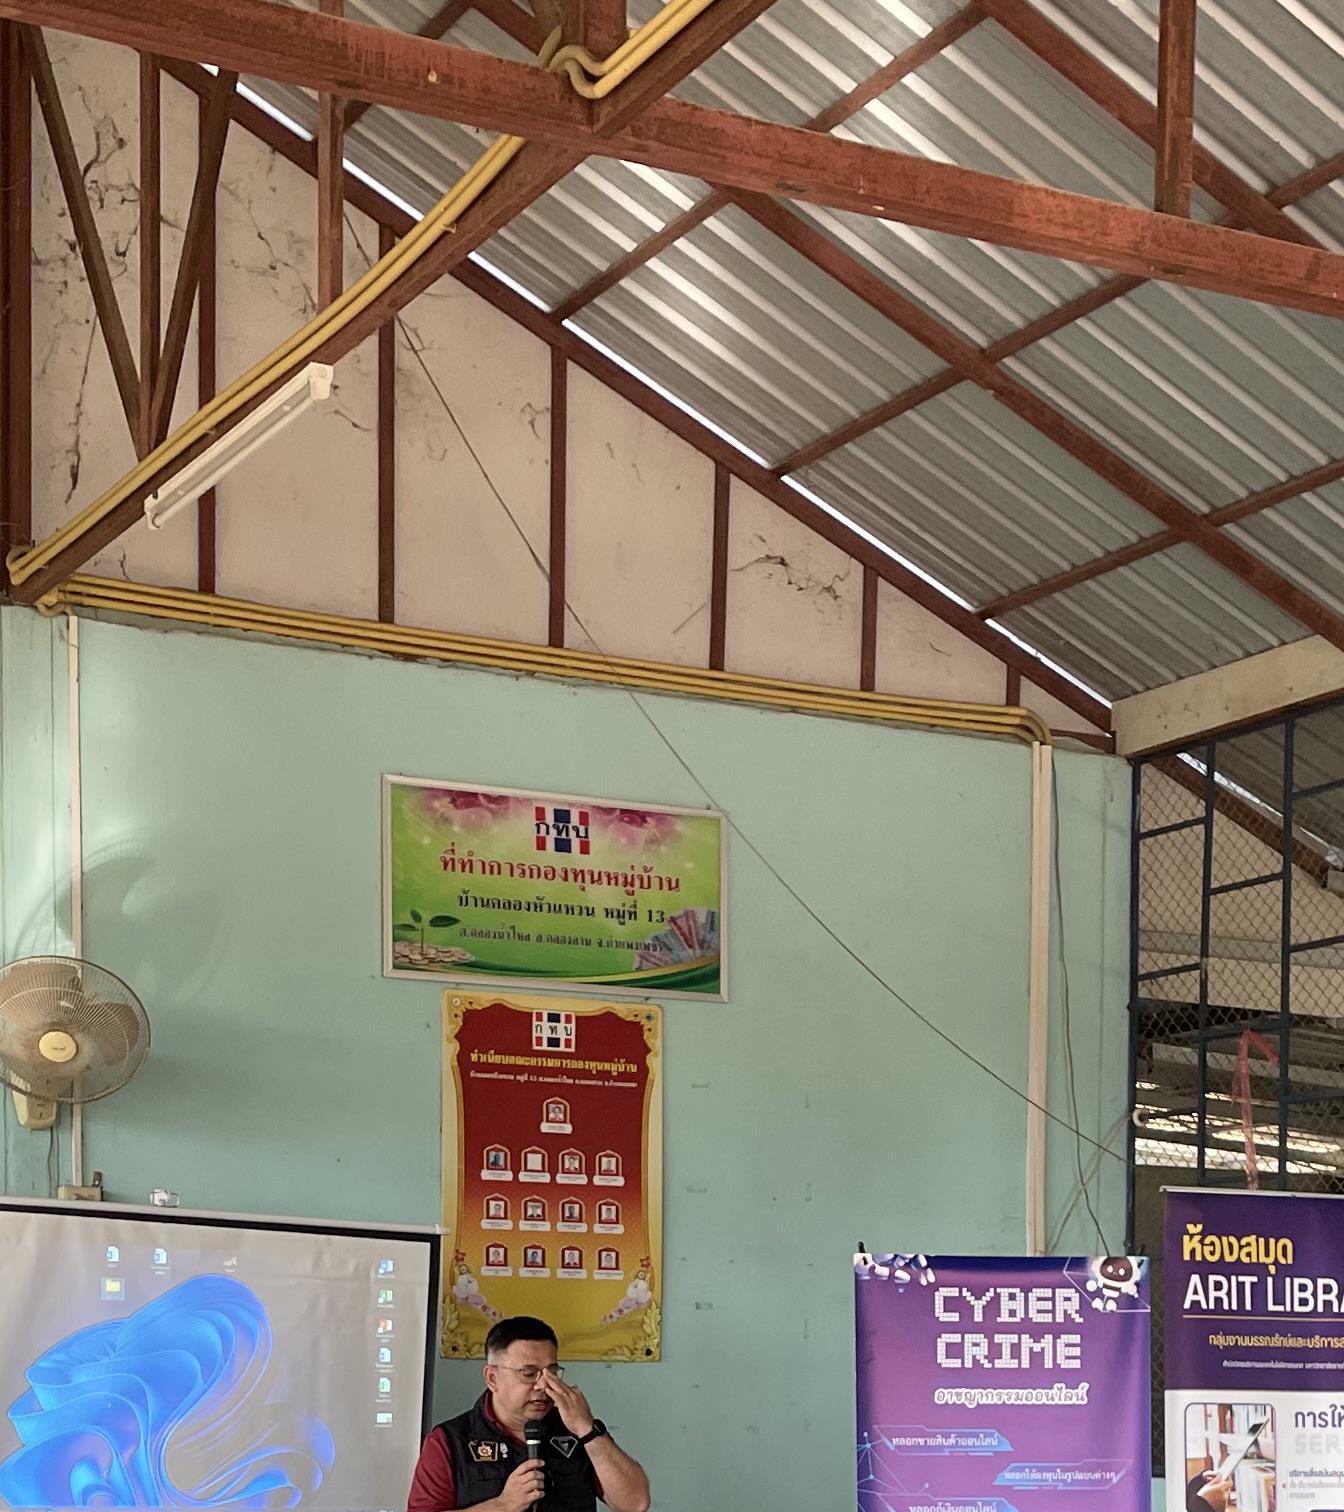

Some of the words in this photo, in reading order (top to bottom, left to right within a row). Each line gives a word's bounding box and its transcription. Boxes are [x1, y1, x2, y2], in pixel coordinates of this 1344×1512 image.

[440, 842, 680, 897] ที่ทำการกองทุนหมู่บ้าน
[457, 889, 596, 918] บ้านคลองหัวแหวน
[604, 899, 638, 927] หมู่ที่
[646, 907, 665, 923] 13
[1183, 1223, 1294, 1275] ห้องสมุด
[934, 1287, 1084, 1323] CYBER
[1183, 1274, 1258, 1311] ARIT
[936, 1333, 1082, 1369] CRIME
[934, 1381, 1090, 1408] อาชญากรรมออนไลน์
